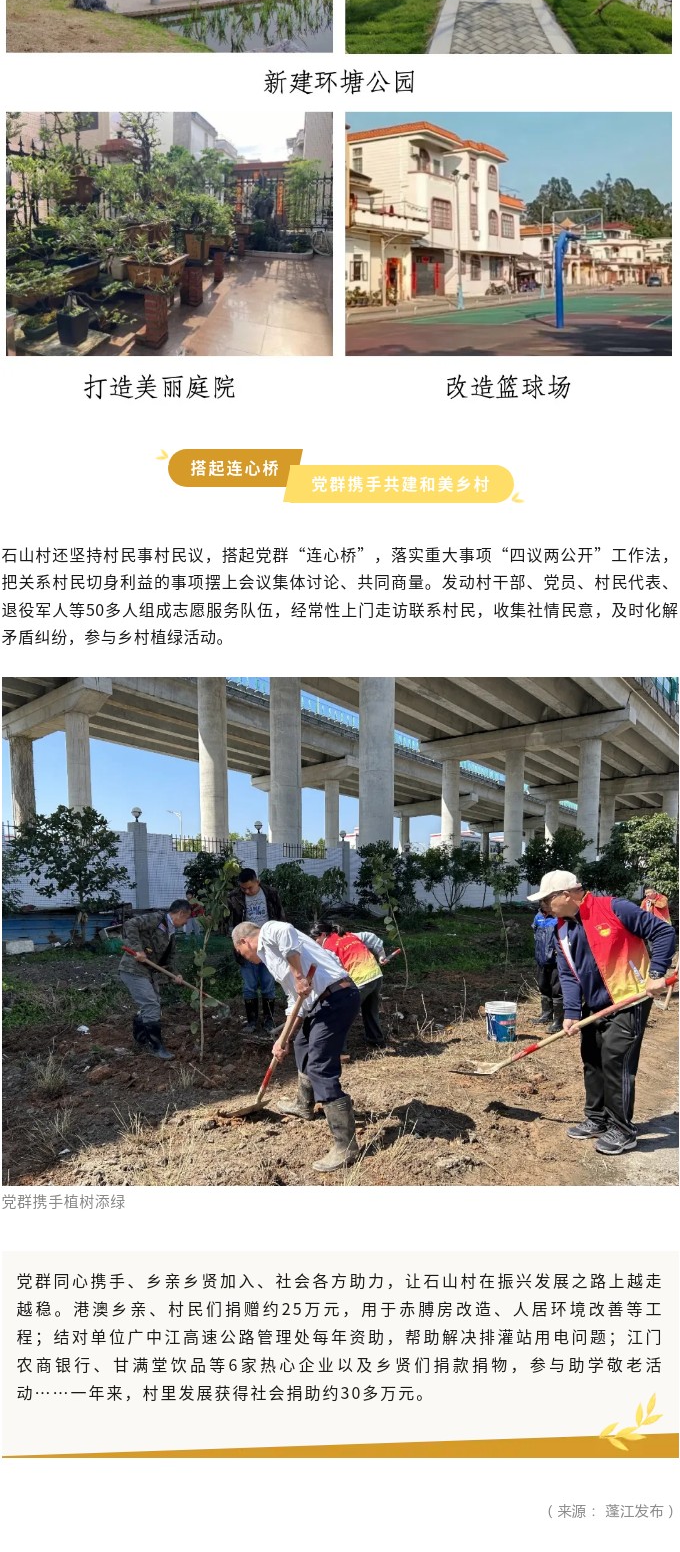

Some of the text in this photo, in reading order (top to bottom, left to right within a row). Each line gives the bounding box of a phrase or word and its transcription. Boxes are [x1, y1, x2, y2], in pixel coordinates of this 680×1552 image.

[190, 460, 279, 477] 搭起连心桥
[311, 476, 490, 493] 党群携手共建和美乡村
[2, 547, 670, 563] 石山村还坚持村民事村民议，搭起党群“连心桥”，落实重大事项“四议两公开”工作法，
[2, 574, 671, 590] 把关系村民切身利益的事项摆上会议集体讨论、共同商量。发动村干部、党员、村民代表、
[2, 602, 677, 618] 退役军人等50多人组成志愿服务队伍，经常性上门走访联系村民，收集社情民意，及时化解
[2, 629, 224, 645] 矛盾纠纷，参与乡村植绿活动。
[17, 1273, 661, 1289] 党群同心携手、乡亲乡贤加入、社会各方助力，让石山村在振兴发展之路上越走
[17, 1301, 661, 1317] 越稳。港澳乡亲、村民们捐赠约25万元，用于赤膊房改造、人居环境改善等工
[17, 1329, 661, 1346] 程；结对单位广中江高速公路管理处每年资助，帮助解决排灌站用电问题；江门
[17, 1357, 661, 1373] 农商银行、甘满堂饮品等6家热心企业以及乡贤们捐款捐物，参与助学敬老活
[17, 1385, 424, 1401] 动……一年来，村里发展获得社会捐助约30多万元。
